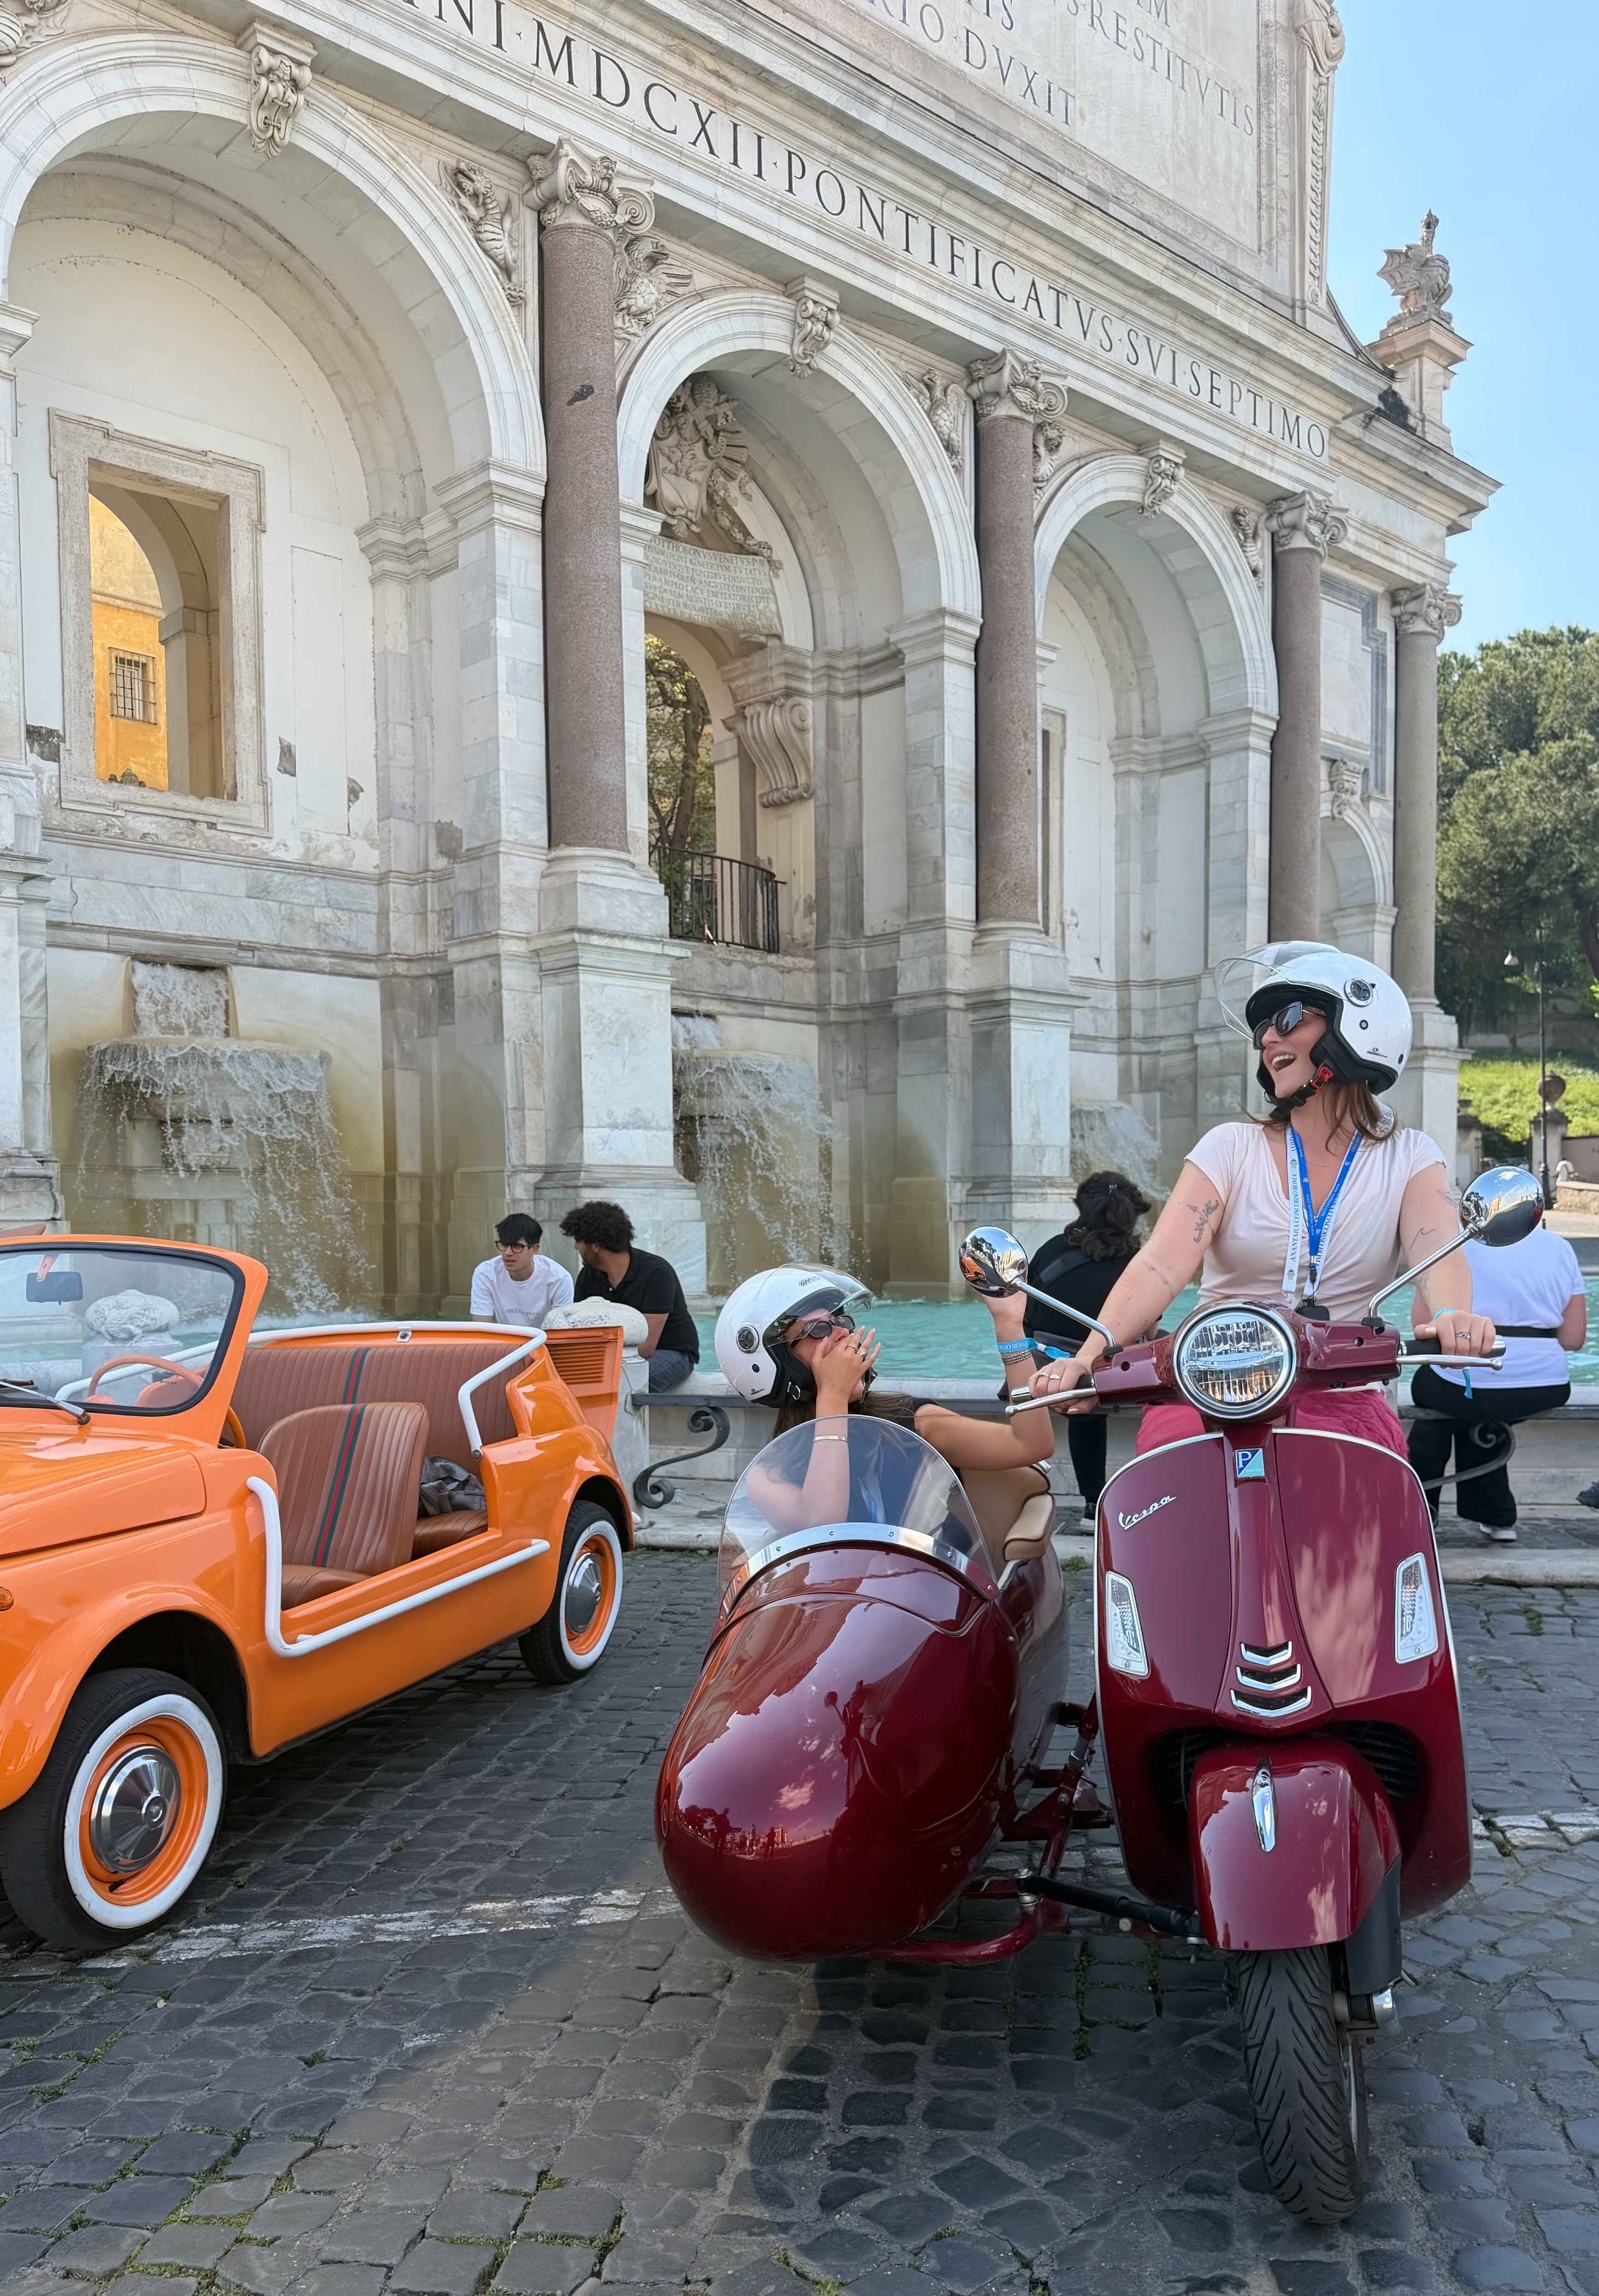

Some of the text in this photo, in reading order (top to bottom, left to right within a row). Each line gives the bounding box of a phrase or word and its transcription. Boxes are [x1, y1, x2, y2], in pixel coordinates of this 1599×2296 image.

[963, 26, 1075, 127] DVXIT
[1088, 0, 1253, 136] RESTITVTIS
[532, 18, 766, 181] MDCXII
[785, 148, 1112, 353] PONTIFICATVS
[1126, 329, 1179, 387] SVI
[1189, 360, 1325, 458] SEPTIMO
[1238, 1451, 1252, 1468] P
[1118, 1495, 1177, 1530] Vespa
